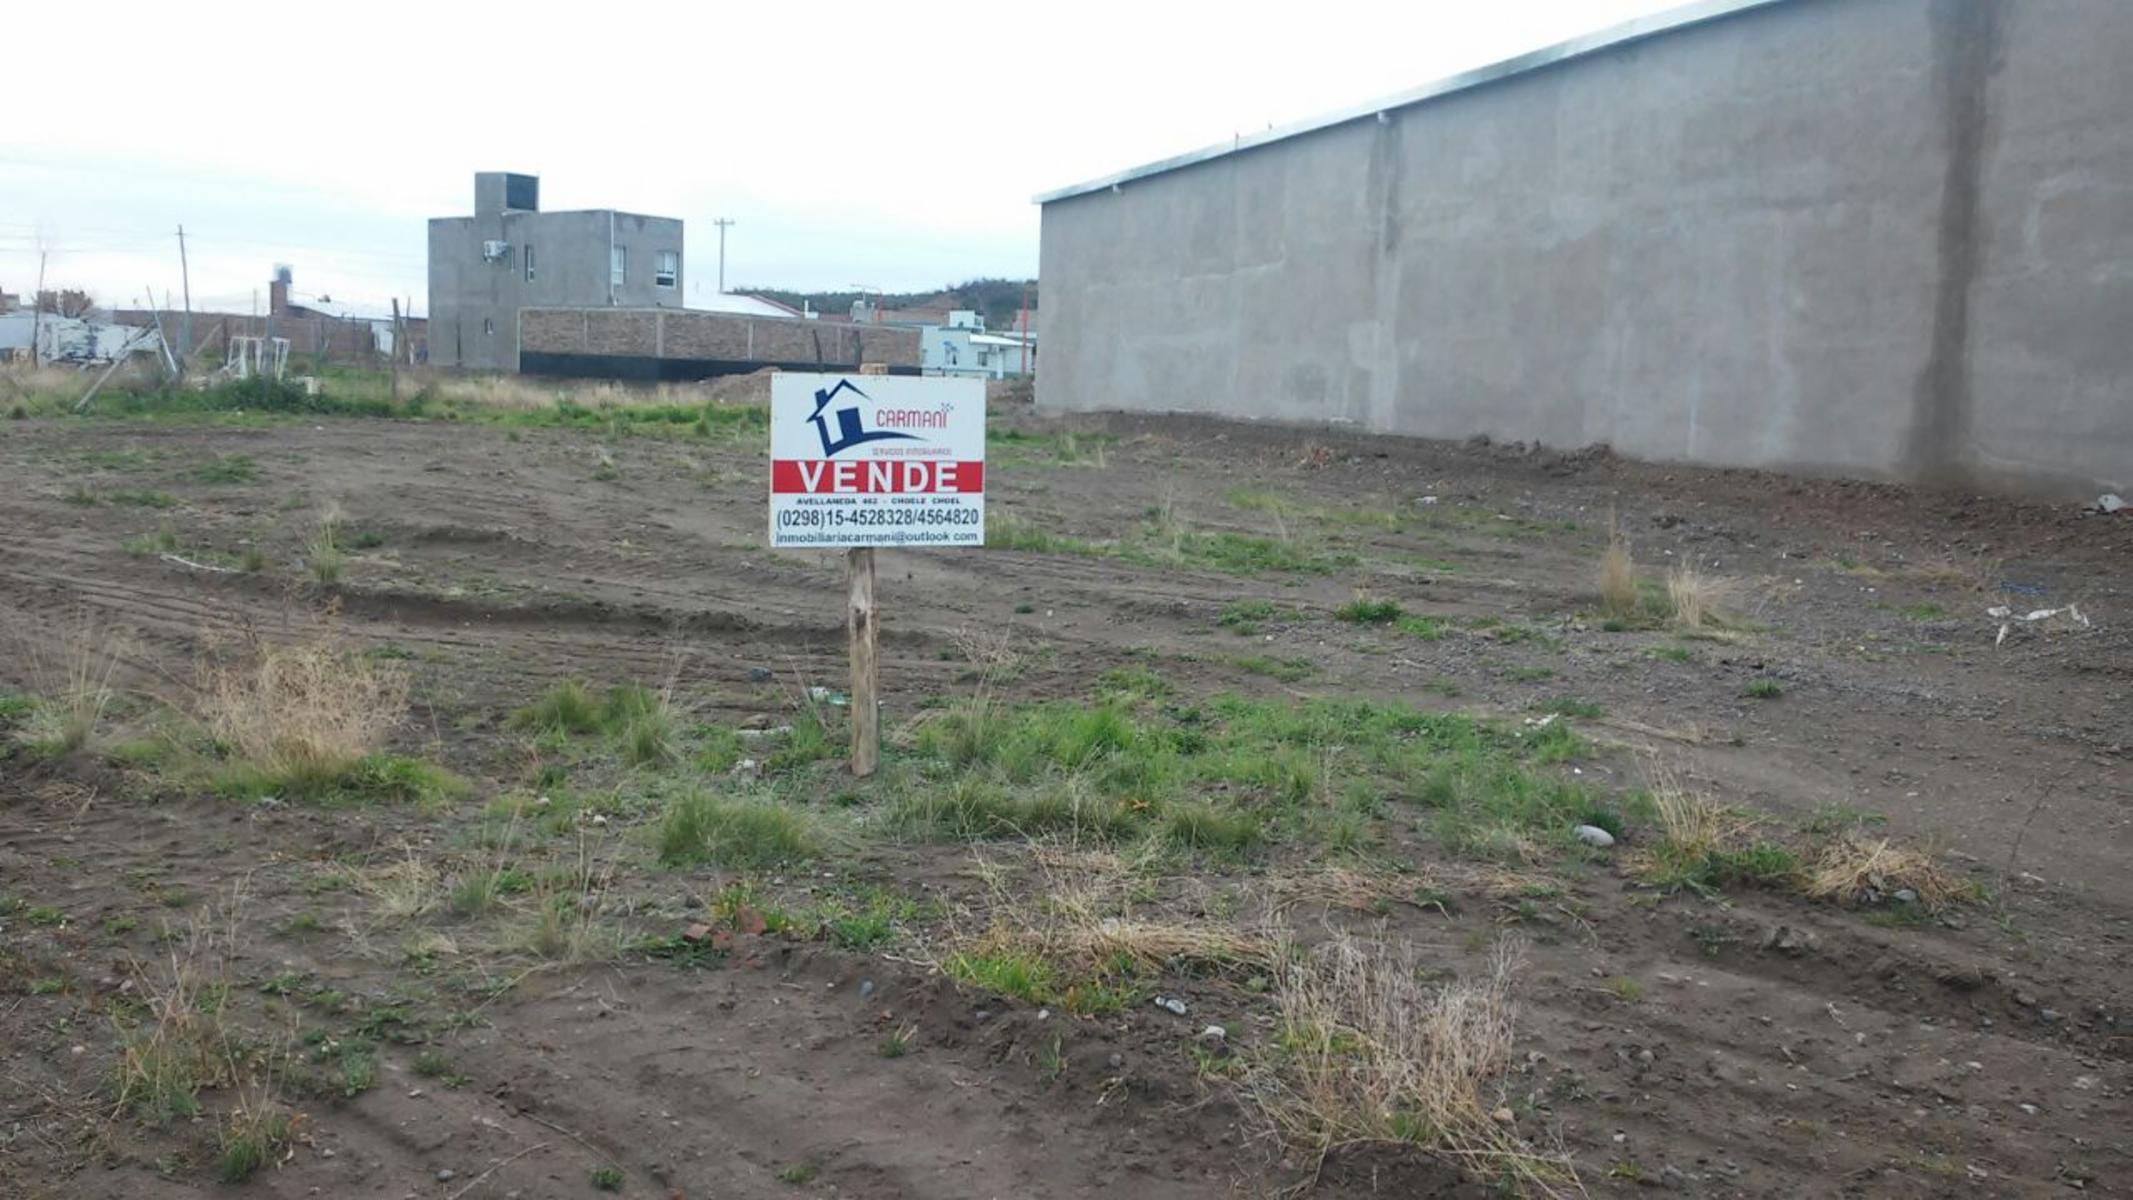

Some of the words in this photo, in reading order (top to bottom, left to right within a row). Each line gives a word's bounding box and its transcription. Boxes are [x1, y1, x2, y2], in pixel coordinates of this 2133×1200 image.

[798, 461, 959, 492] VENDE
[891, 497, 926, 505] CHOELE
[777, 508, 979, 530] (0298)15-4528328/4564820
[776, 530, 978, 544] inmobiliariacarmani@outlookcom
